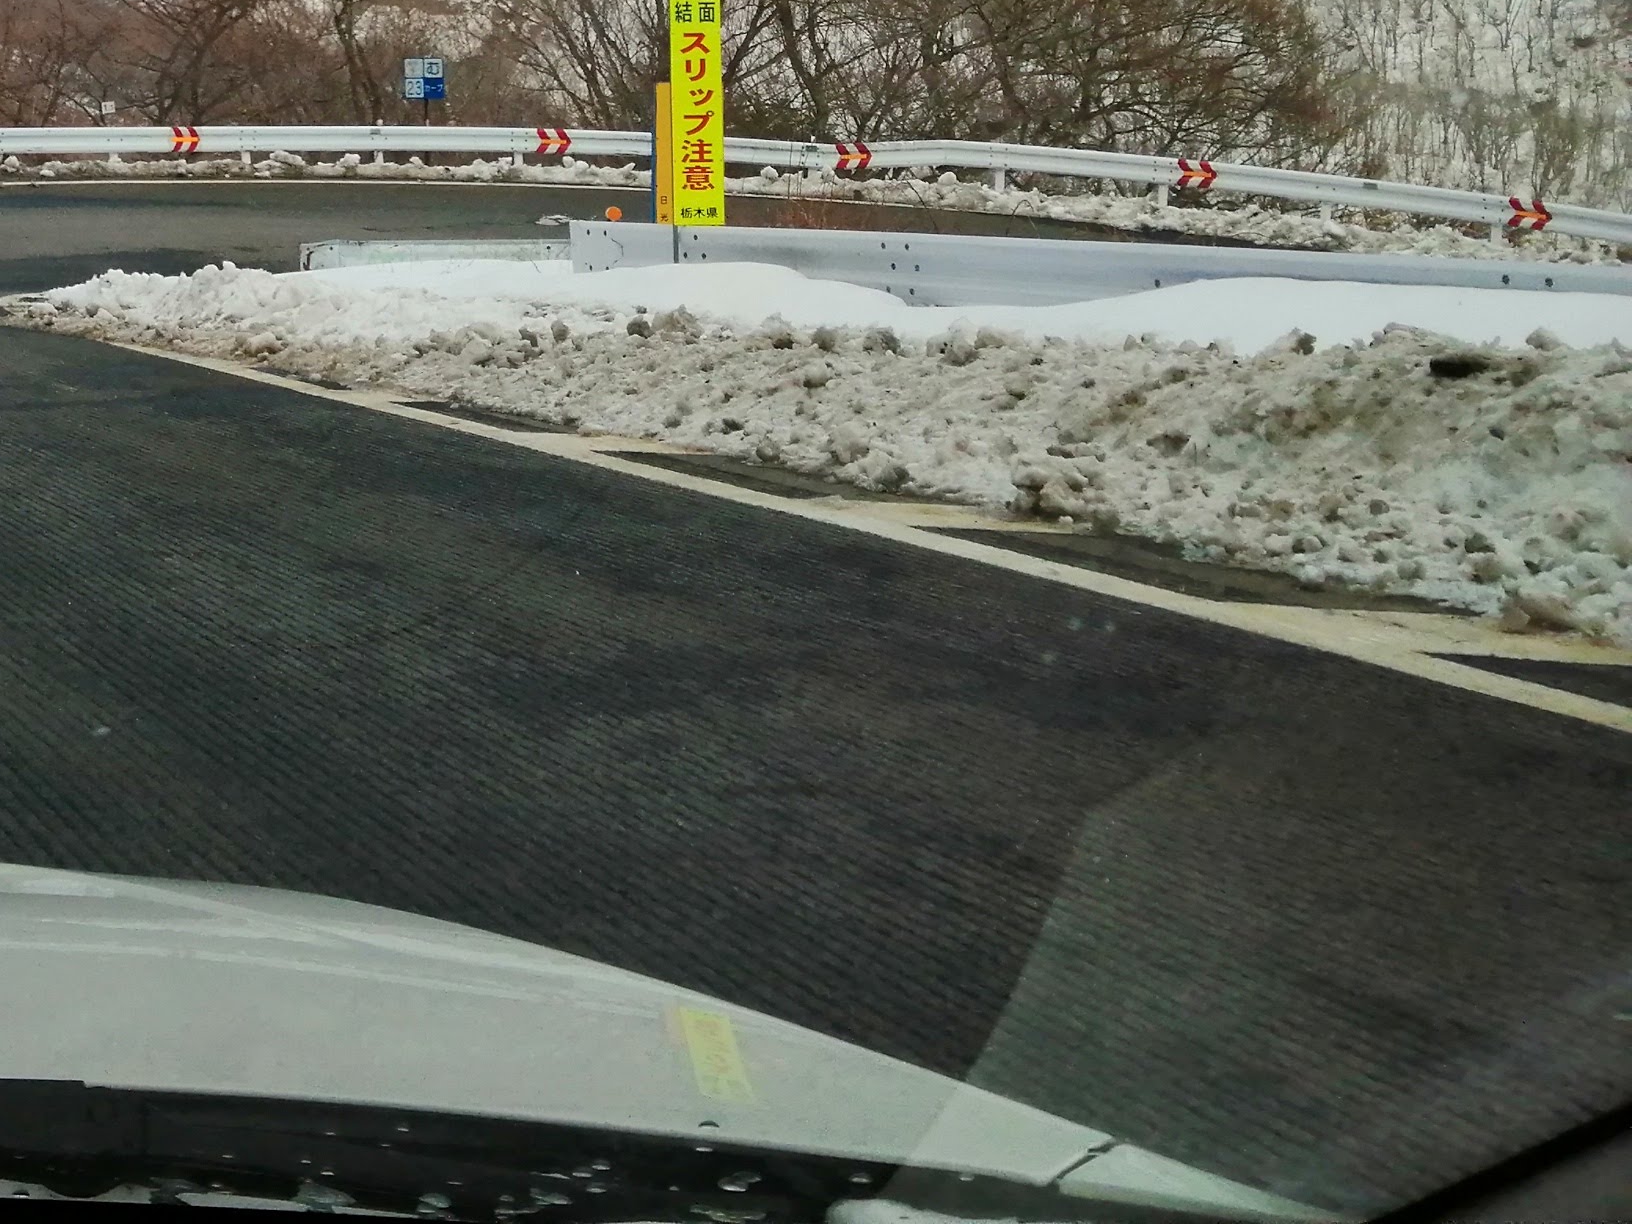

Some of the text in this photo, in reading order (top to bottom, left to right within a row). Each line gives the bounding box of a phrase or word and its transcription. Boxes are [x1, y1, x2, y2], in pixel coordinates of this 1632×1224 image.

[426, 62, 440, 75] む
[407, 80, 422, 95] 23
[680, 32, 715, 190] スリップ注意
[680, 207, 719, 219] 栃木県
